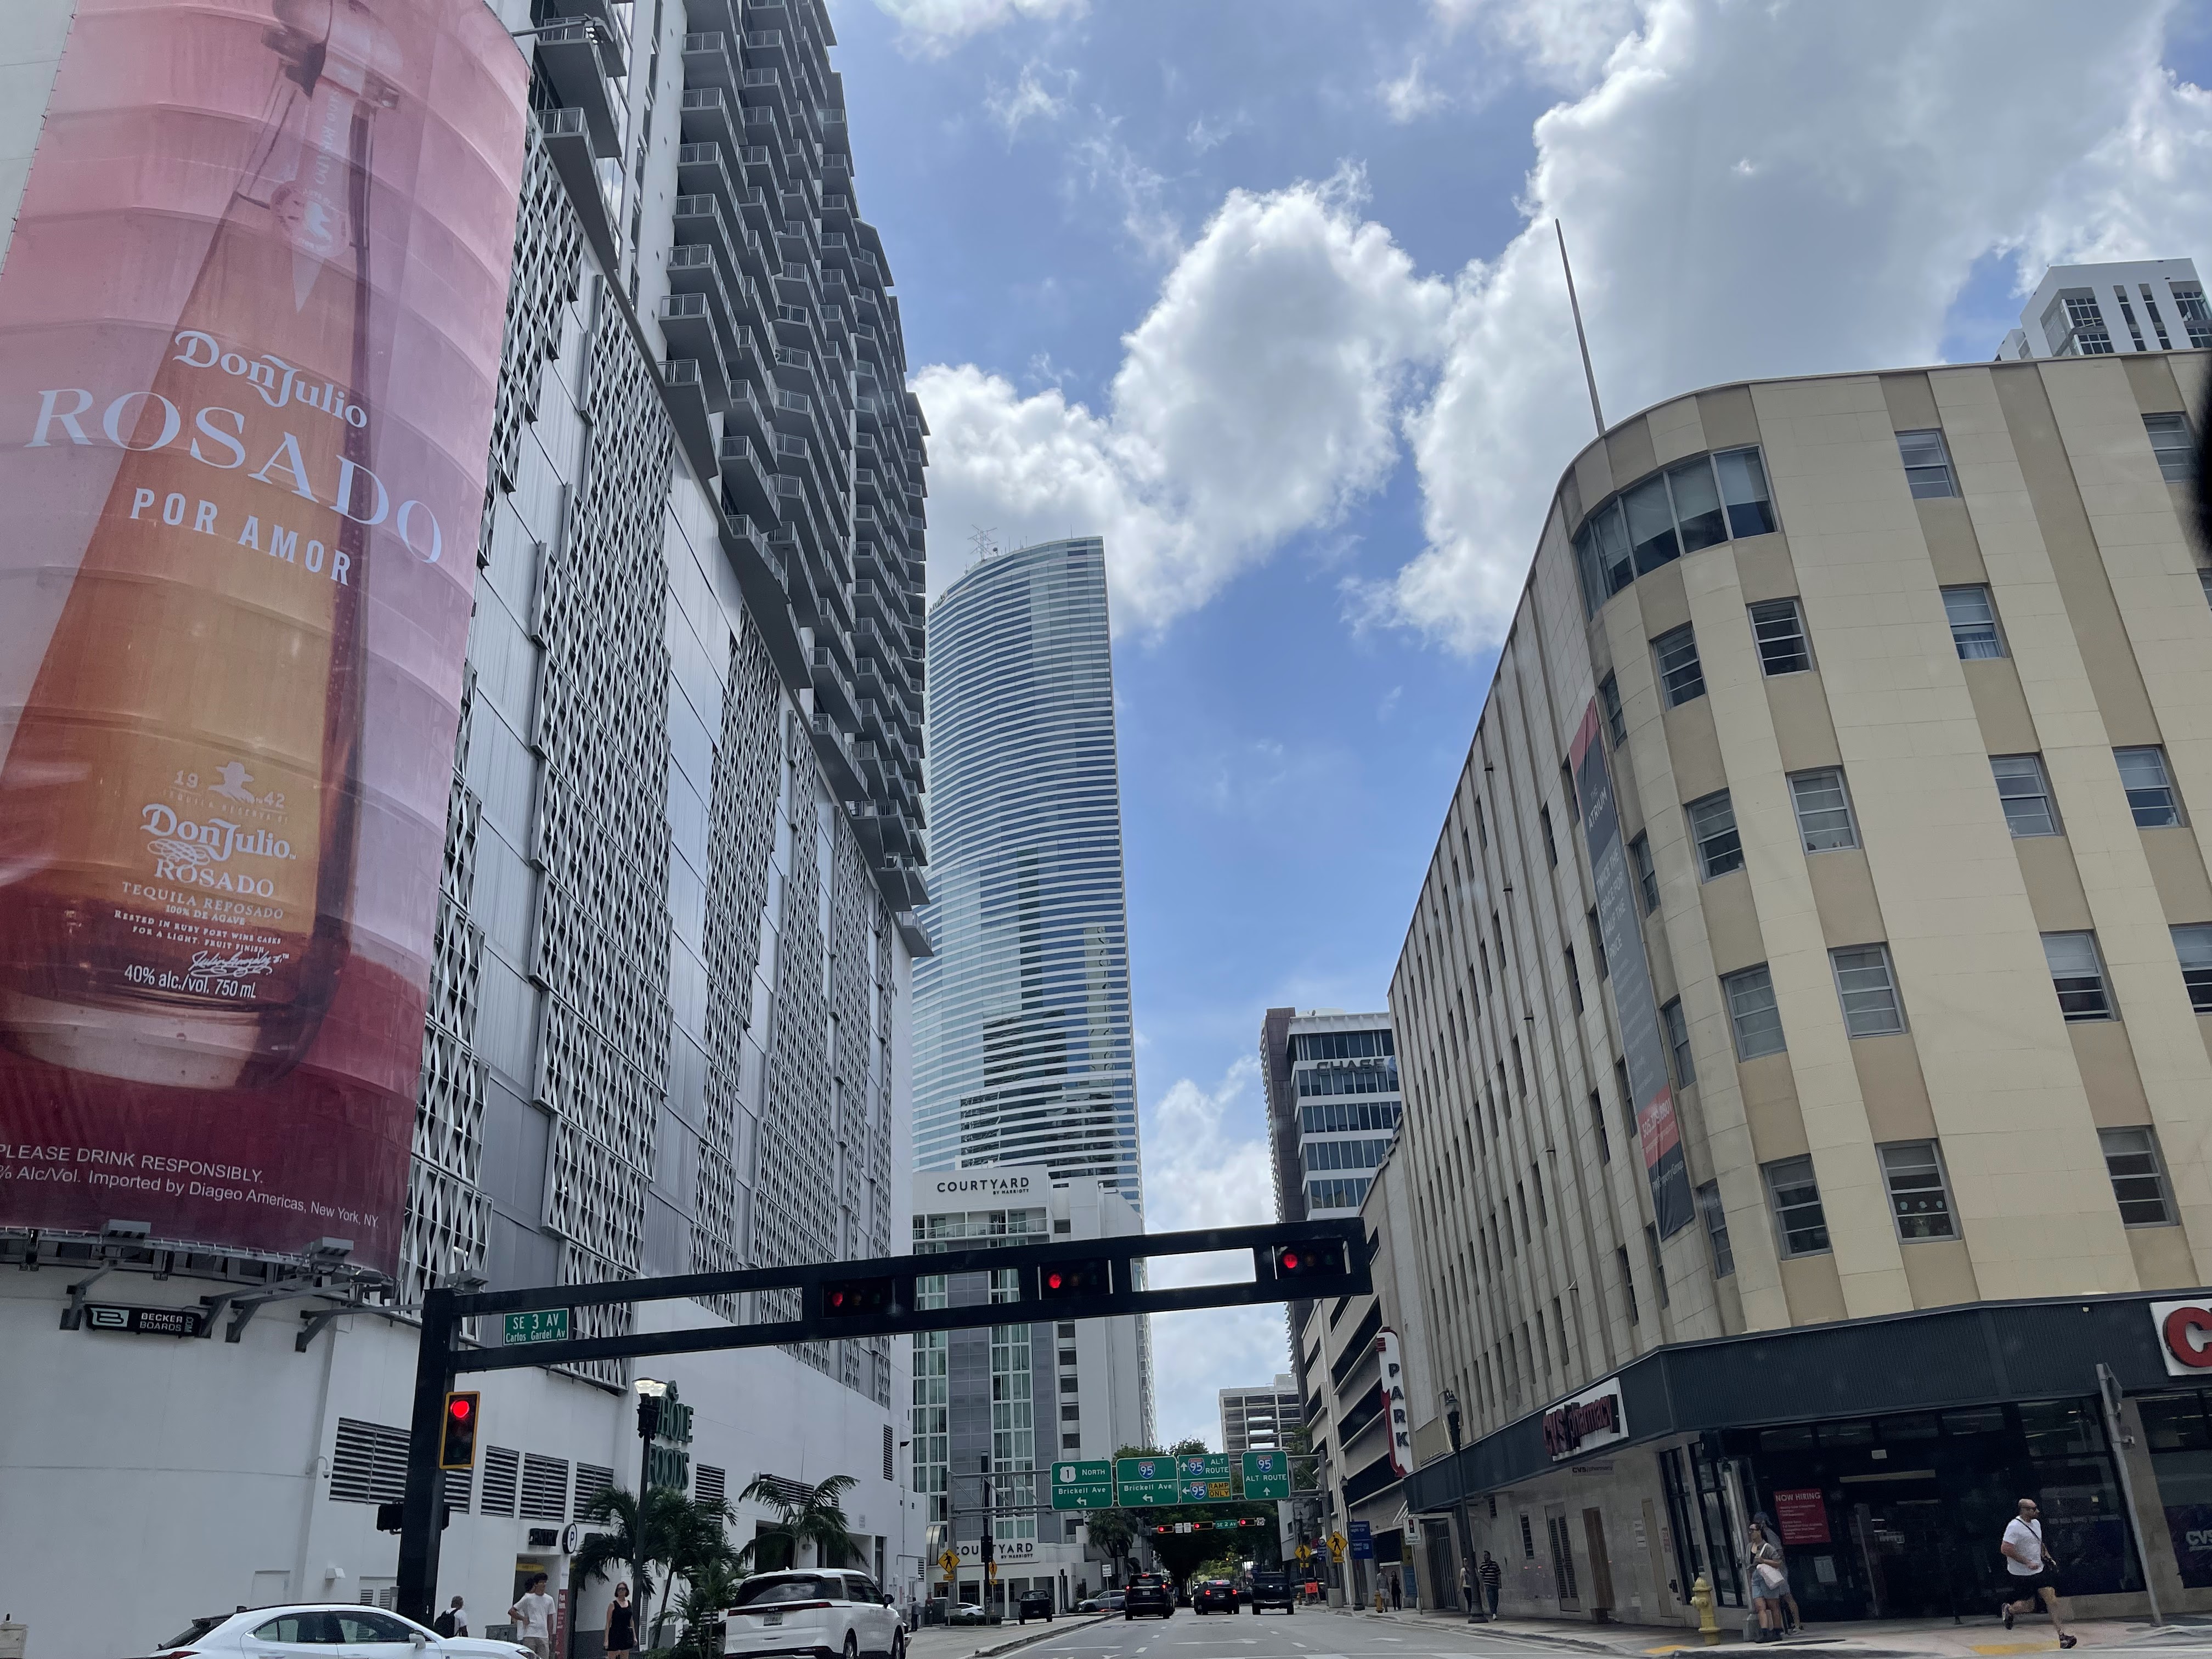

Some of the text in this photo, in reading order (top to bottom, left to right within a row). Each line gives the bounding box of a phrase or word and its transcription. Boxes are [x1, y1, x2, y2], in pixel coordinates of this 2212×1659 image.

[24, 388, 442, 564] ROSADO
[130, 488, 351, 586] POR AMOR
[174, 770, 285, 809] 19 42
[1588, 786, 1607, 832] ATRIUM
[154, 859, 274, 898] ROSADO
[122, 881, 283, 919] TEQUILA REPOSADO
[166, 905, 245, 926] 100% DE AGAVE
[132, 926, 153, 935] FOR
[125, 964, 256, 998] 40% alc./vol. 750 mL
[1317, 1058, 1386, 1076] CHASE
[0, 1144, 264, 1184] PLEASE DRINK RESPONSIBLY.
[937, 1177, 1029, 1192] COURTYARD
[16, 1166, 81, 1183] Alc/Vol.
[88, 1170, 161, 1192] Imported
[166, 1177, 185, 1196] by
[189, 1182, 242, 1201] Diageo
[246, 1188, 307, 1215] Americas,
[311, 1201, 335, 1217] New
[337, 1207, 361, 1225] York,
[139, 1321, 182, 1332] BOARDS
[141, 1312, 183, 1323] BECKER
[513, 1313, 559, 1330] SE 3 AV
[506, 1328, 566, 1343] Carlos Gardel Av
[2163, 1307, 2212, 1368] C
[1389, 1363, 1409, 1447] PARK
[656, 1396, 693, 1443] HOLE
[648, 1443, 690, 1489] FOODS
[1139, 1466, 1153, 1476] 95
[1189, 1462, 1203, 1472] 95
[1258, 1459, 1271, 1469] 95
[1066, 1470, 1070, 1479] 1
[1192, 1486, 1205, 1496] 95
[569, 1532, 574, 1547] P
[957, 1543, 1033, 1555] OUTYARD
